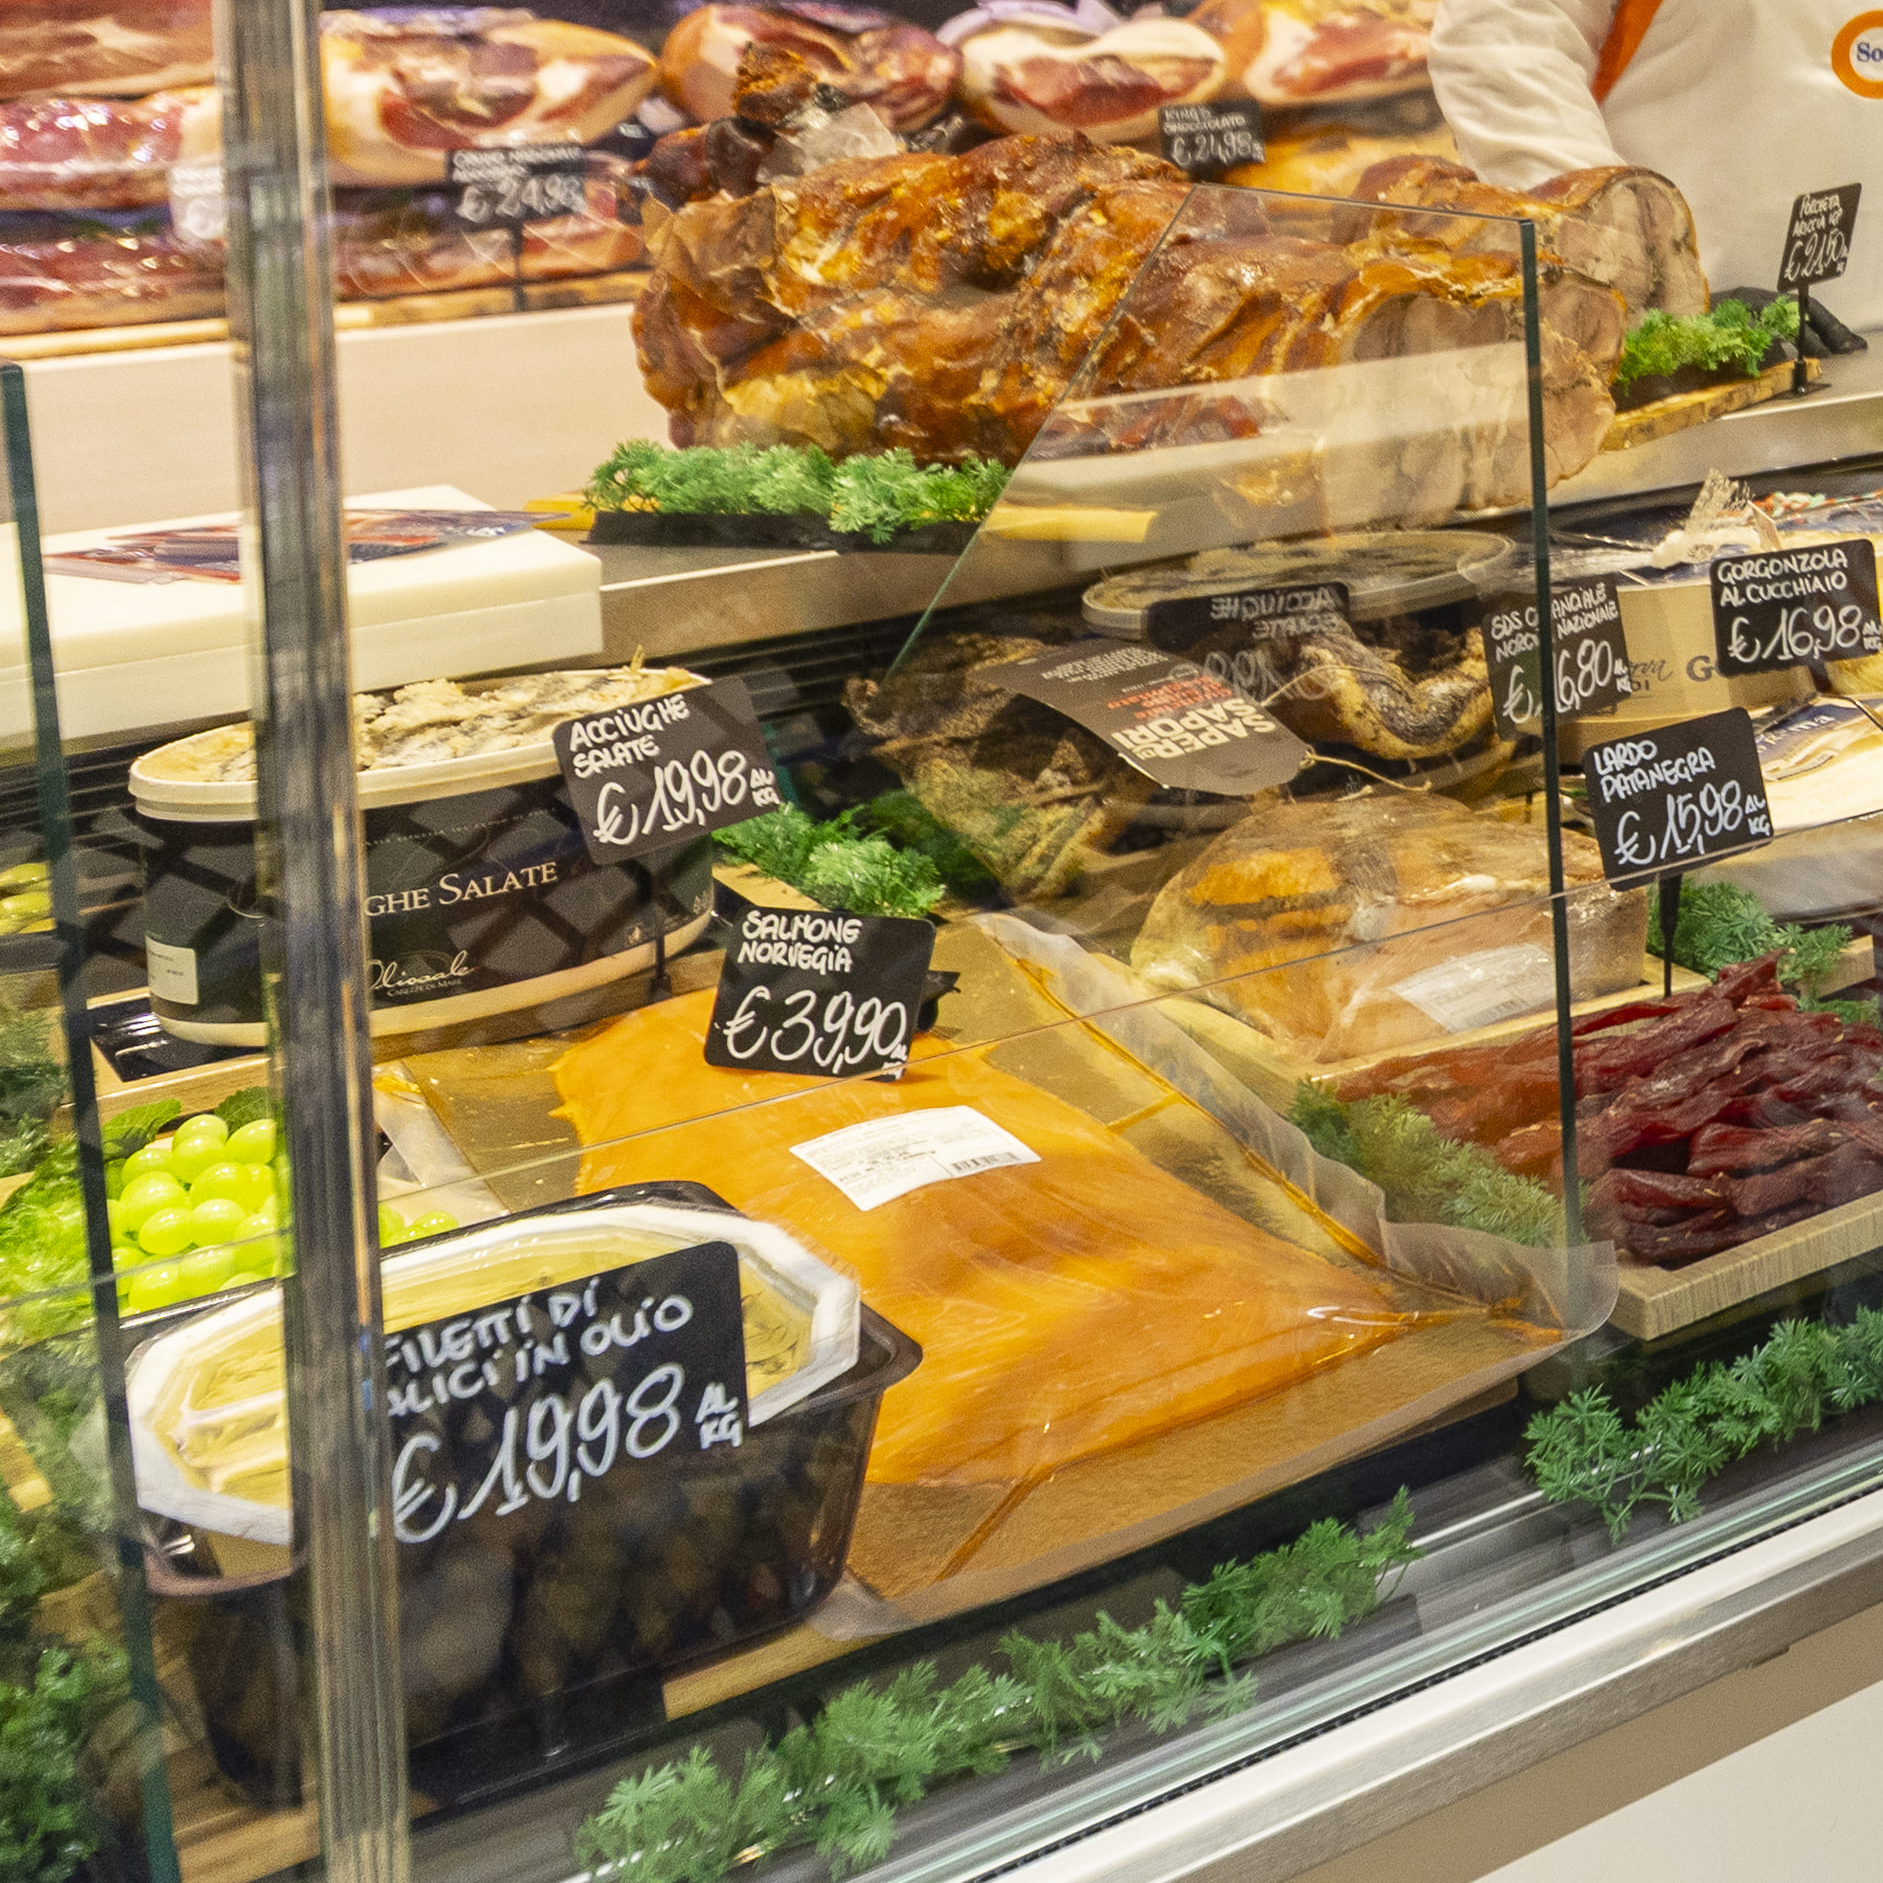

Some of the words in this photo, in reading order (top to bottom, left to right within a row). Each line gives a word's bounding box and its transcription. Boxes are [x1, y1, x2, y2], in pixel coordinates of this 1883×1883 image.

[1717, 548, 1849, 585] GORGONZOLA
[1746, 572, 1848, 605] CUCCHIAIO
[1557, 601, 1618, 640] NAZIONALE
[1727, 617, 1760, 662] €
[1761, 604, 1864, 661] 16,98
[1502, 665, 1533, 724] €
[569, 694, 690, 752] ACCIUGHE
[1111, 698, 1246, 749] SAPORI
[1151, 717, 1277, 759] SAPER
[573, 734, 660, 779] SALATE
[1594, 739, 1657, 774] LARDO
[1601, 747, 1716, 803] PATANEGRA
[594, 782, 640, 846] €
[642, 749, 748, 835] 19,98
[1614, 810, 1656, 868] €
[1660, 779, 1744, 859] 15,98
[1748, 814, 1771, 837] KG
[742, 910, 862, 944] SALMONE
[737, 943, 854, 975] NORVEGIA
[724, 985, 771, 1060] €
[771, 989, 908, 1074] 39,90
[548, 1277, 600, 1329] DI
[517, 1334, 568, 1384] IN
[580, 1296, 694, 1356] OLIO
[696, 1384, 738, 1422] AL
[392, 1433, 457, 1543] €
[457, 1363, 687, 1521] 19,98
[701, 1420, 744, 1449] KG
